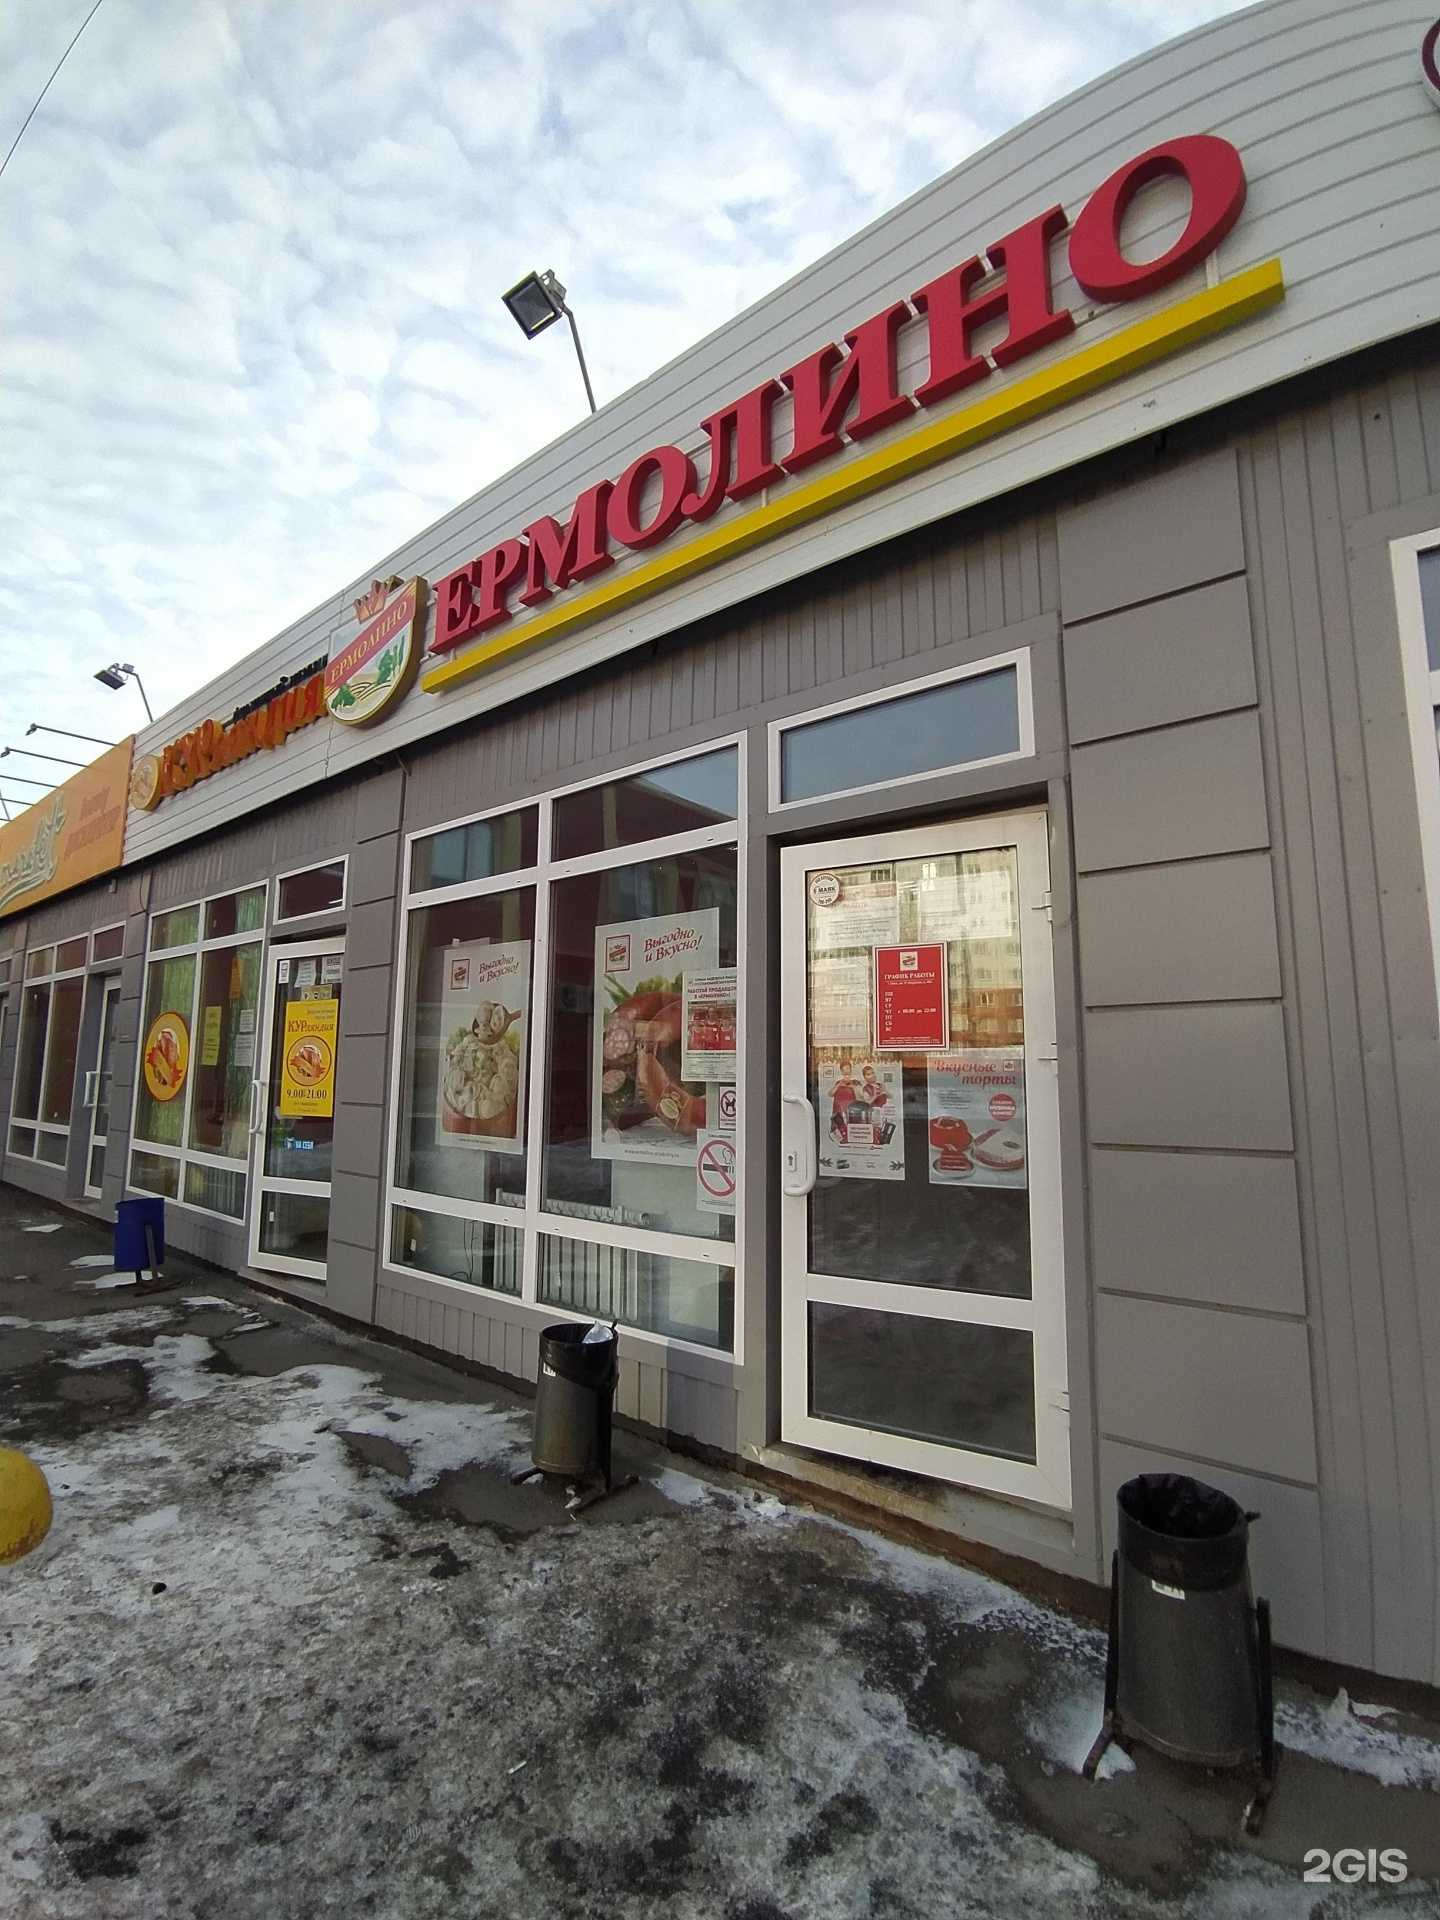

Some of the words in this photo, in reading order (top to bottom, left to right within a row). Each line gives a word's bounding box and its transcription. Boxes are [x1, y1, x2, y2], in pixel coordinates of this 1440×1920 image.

[428, 134, 1247, 655] ЕРМОЛИНО
[330, 601, 408, 684] ЕРМОЛИНО
[643, 927, 695, 953] Выгодно
[644, 953, 653, 963] и
[655, 935, 703, 961] Вкусно!
[935, 1060, 998, 1078] Вкусные
[961, 1074, 1017, 1090] торты
